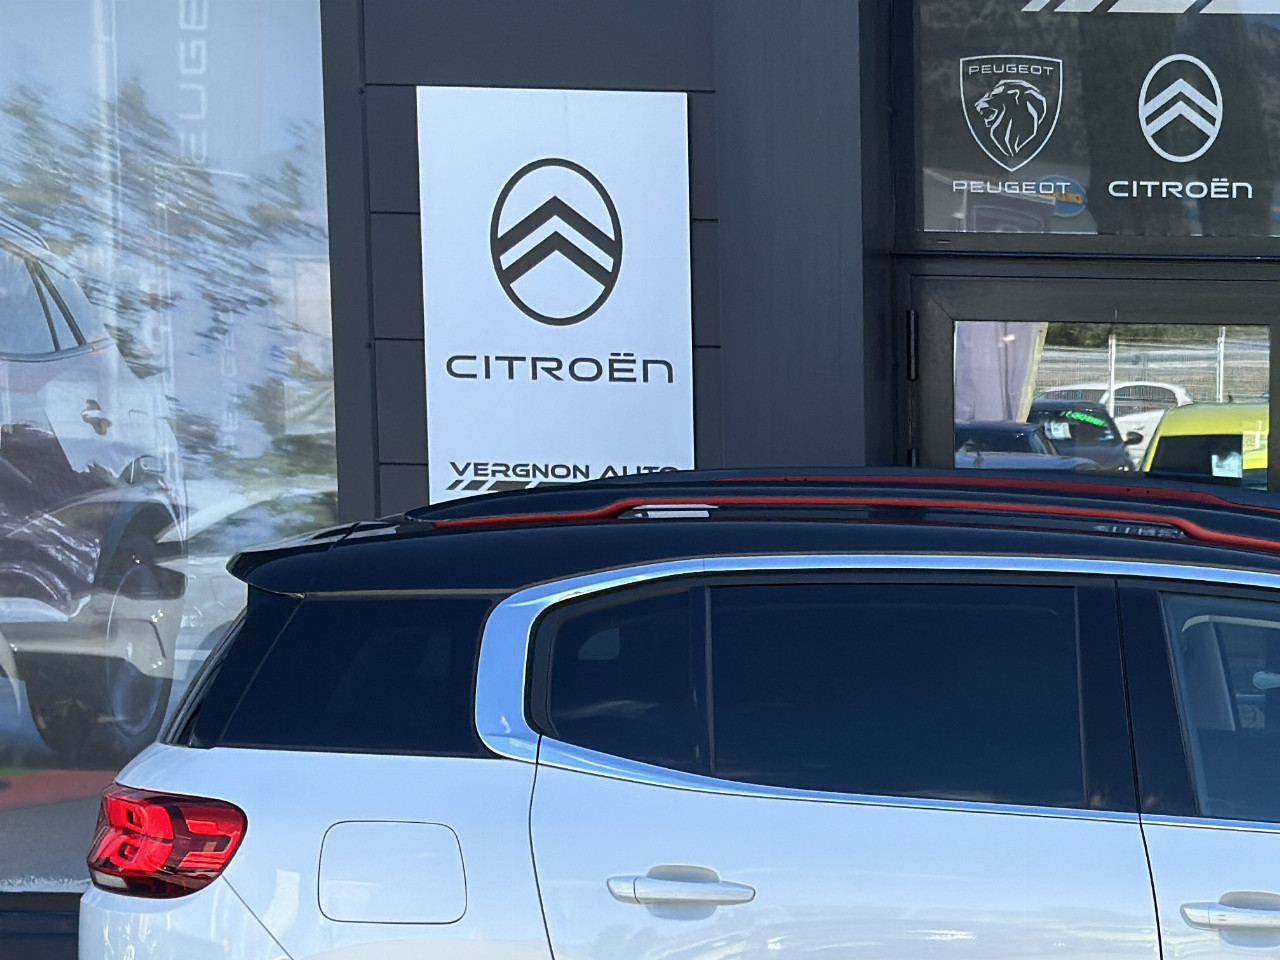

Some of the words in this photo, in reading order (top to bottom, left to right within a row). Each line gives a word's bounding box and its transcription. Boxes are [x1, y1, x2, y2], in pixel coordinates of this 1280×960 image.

[968, 64, 1054, 76] PEUGEOT
[953, 180, 1071, 194] PEUGEOT
[449, 461, 590, 480] VERGNON
[601, 465, 680, 478] AUT
